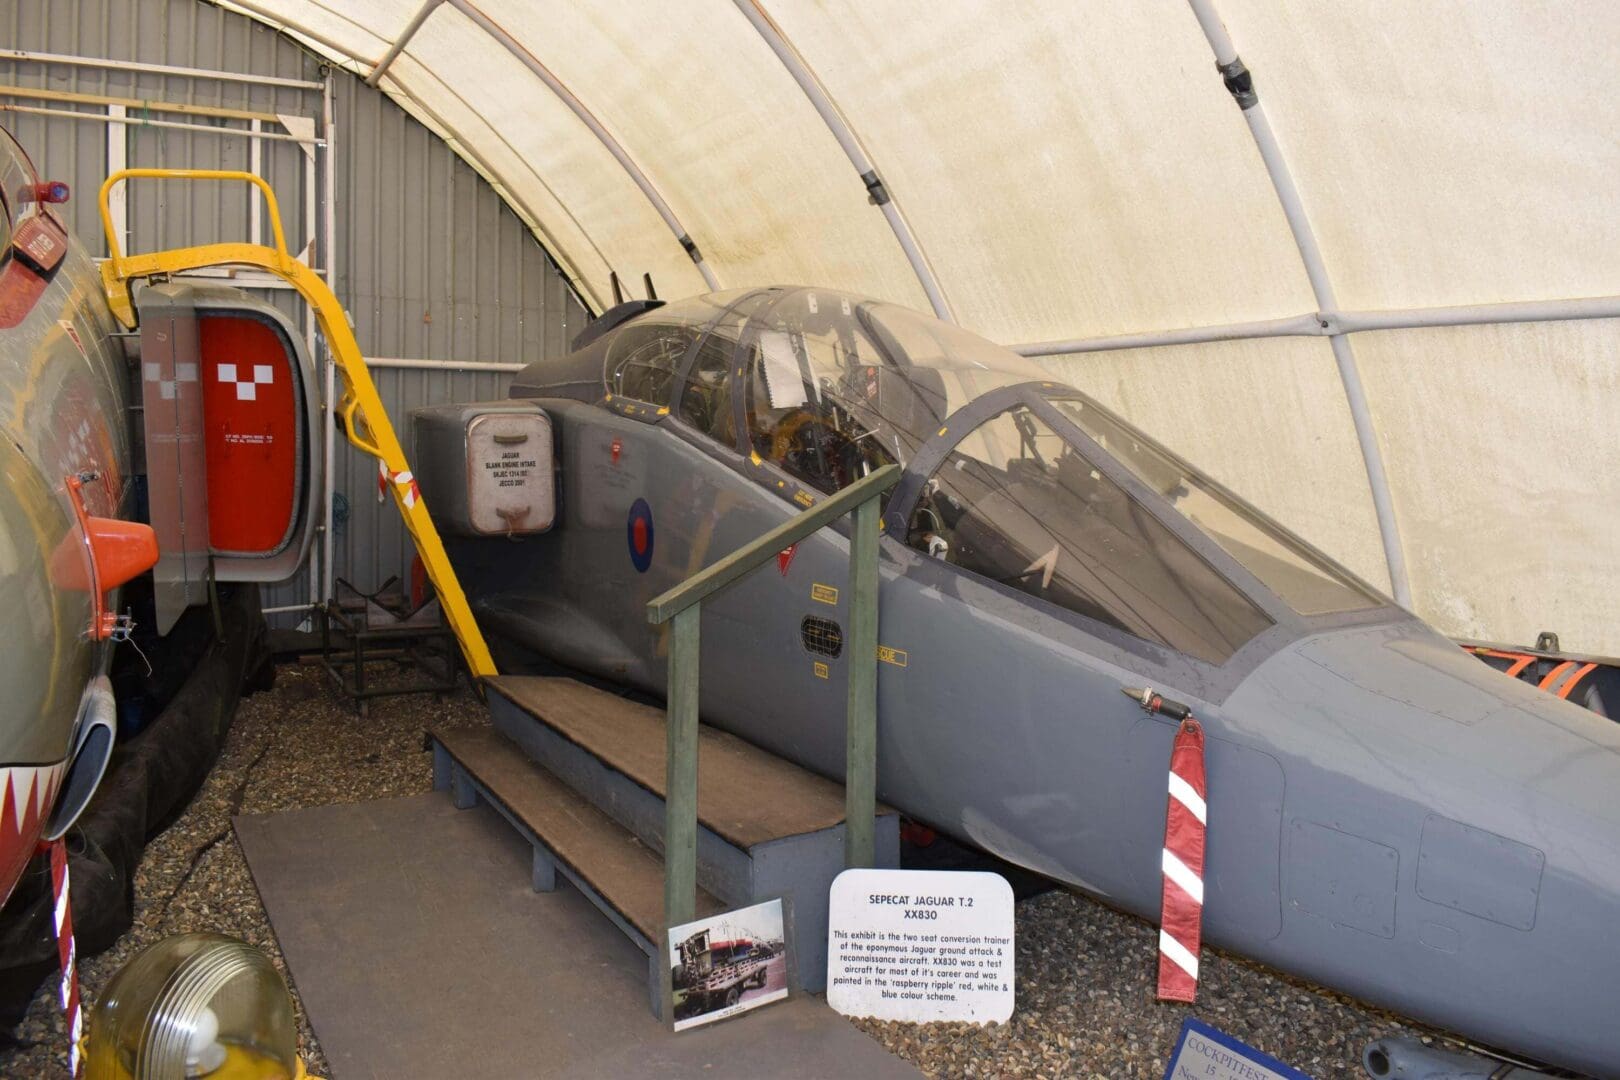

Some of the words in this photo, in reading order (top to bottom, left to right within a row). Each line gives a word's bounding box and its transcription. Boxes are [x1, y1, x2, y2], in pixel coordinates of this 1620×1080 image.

[869, 894, 910, 905] SEPECAT
[914, 896, 954, 906] JAGUAR
[959, 897, 973, 907] T.2
[904, 910, 937, 920] XX830
[834, 930, 848, 939] This
[851, 931, 876, 939] exhibit
[879, 932, 885, 940] is
[888, 932, 900, 941] the
[904, 933, 918, 941] two
[921, 934, 937, 942] seat
[940, 935, 980, 944] conversion
[984, 936, 1010, 945] trainer
[840, 942, 848, 950] of
[851, 942, 863, 951] the
[866, 945, 908, 953] eponymous
[911, 945, 936, 955] Jaguar
[939, 947, 966, 956] ground
[969, 947, 994, 956] attack
[997, 948, 1003, 956] &
[840, 954, 896, 964] reconnaissance
[899, 956, 929, 965] aircraft.
[933, 957, 958, 966] XX830
[987, 960, 1002, 968] test
[844, 965, 873, 974] aircraft
[875, 966, 886, 975] for
[889, 967, 908, 976] most
[911, 968, 920, 976] of
[922, 968, 934, 977] it's
[964, 971, 979, 979] and
[982, 972, 998, 980] was
[833, 976, 862, 986] painted
[865, 977, 872, 986] in
[875, 977, 887, 986] the
[959, 982, 974, 991] red,
[977, 983, 999, 991] white
[1002, 983, 1008, 992] &
[881, 989, 898, 999] blue
[900, 991, 924, 1000] colour
[926, 992, 958, 1001] scheme.
